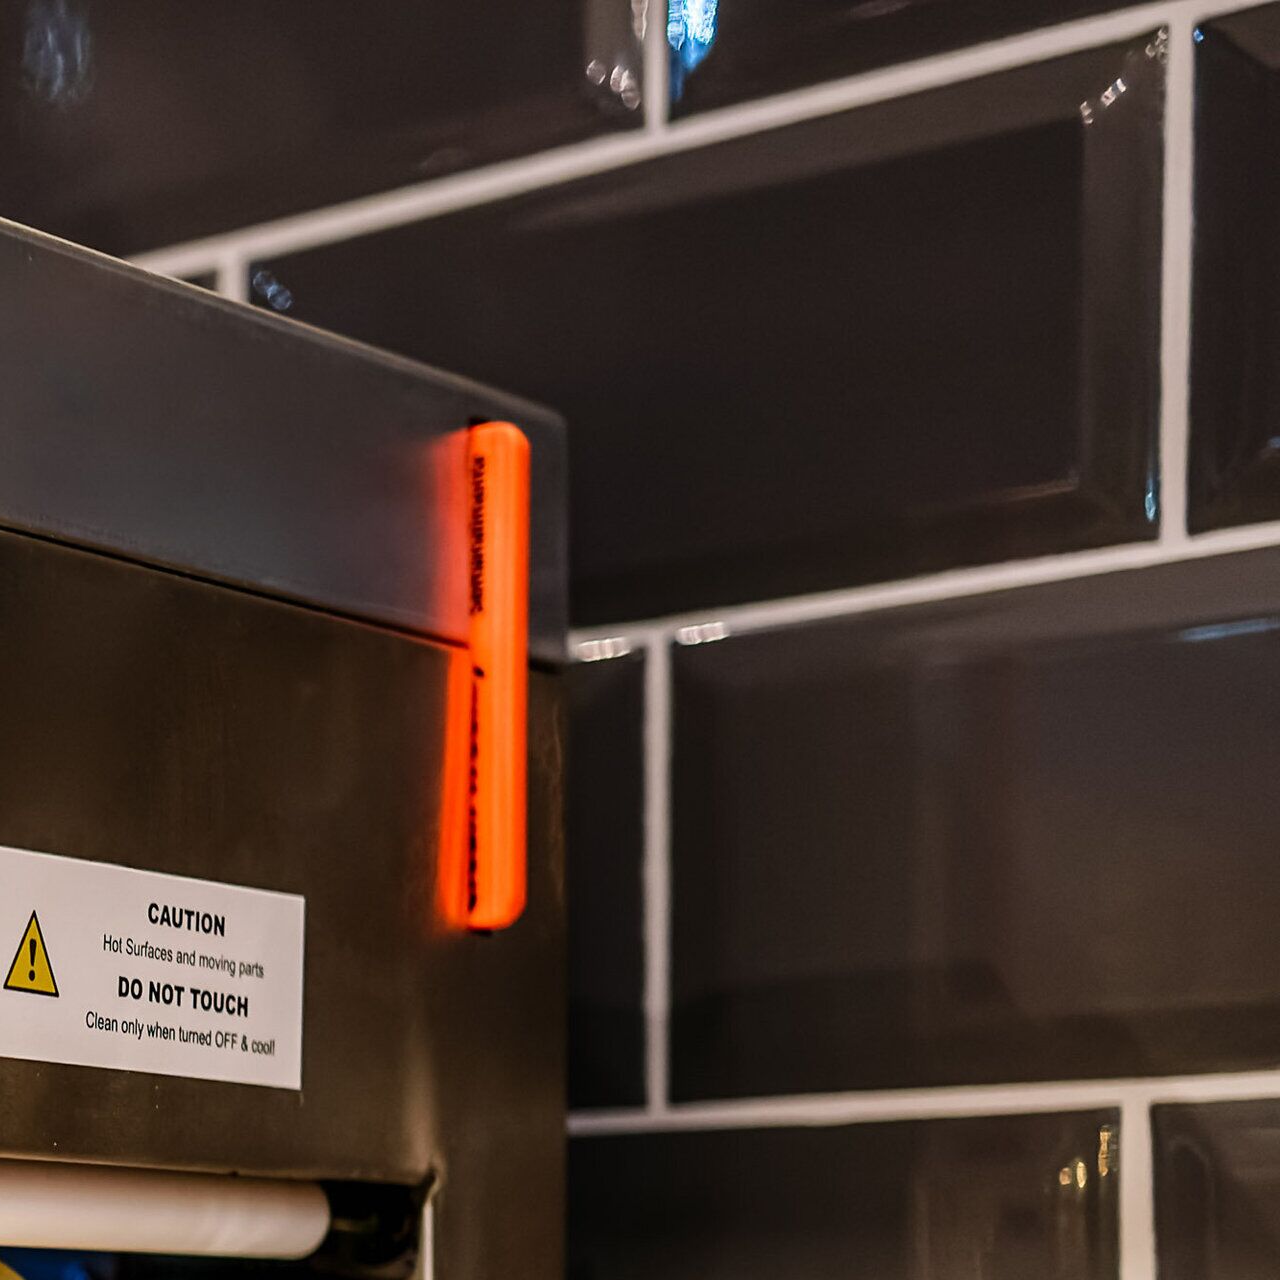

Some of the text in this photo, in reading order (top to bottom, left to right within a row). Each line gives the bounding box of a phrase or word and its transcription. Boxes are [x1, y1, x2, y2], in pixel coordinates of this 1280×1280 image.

[148, 902, 226, 937] CAUTION
[103, 934, 265, 979] Hot Surfaces and moving parts
[118, 975, 249, 1018] DO NOT TOUCH
[85, 1010, 118, 1033] Clean
[121, 1018, 144, 1040] only
[147, 1021, 176, 1041] when
[179, 1026, 212, 1046] turned
[215, 1030, 238, 1050] OFF
[240, 1035, 248, 1052] &
